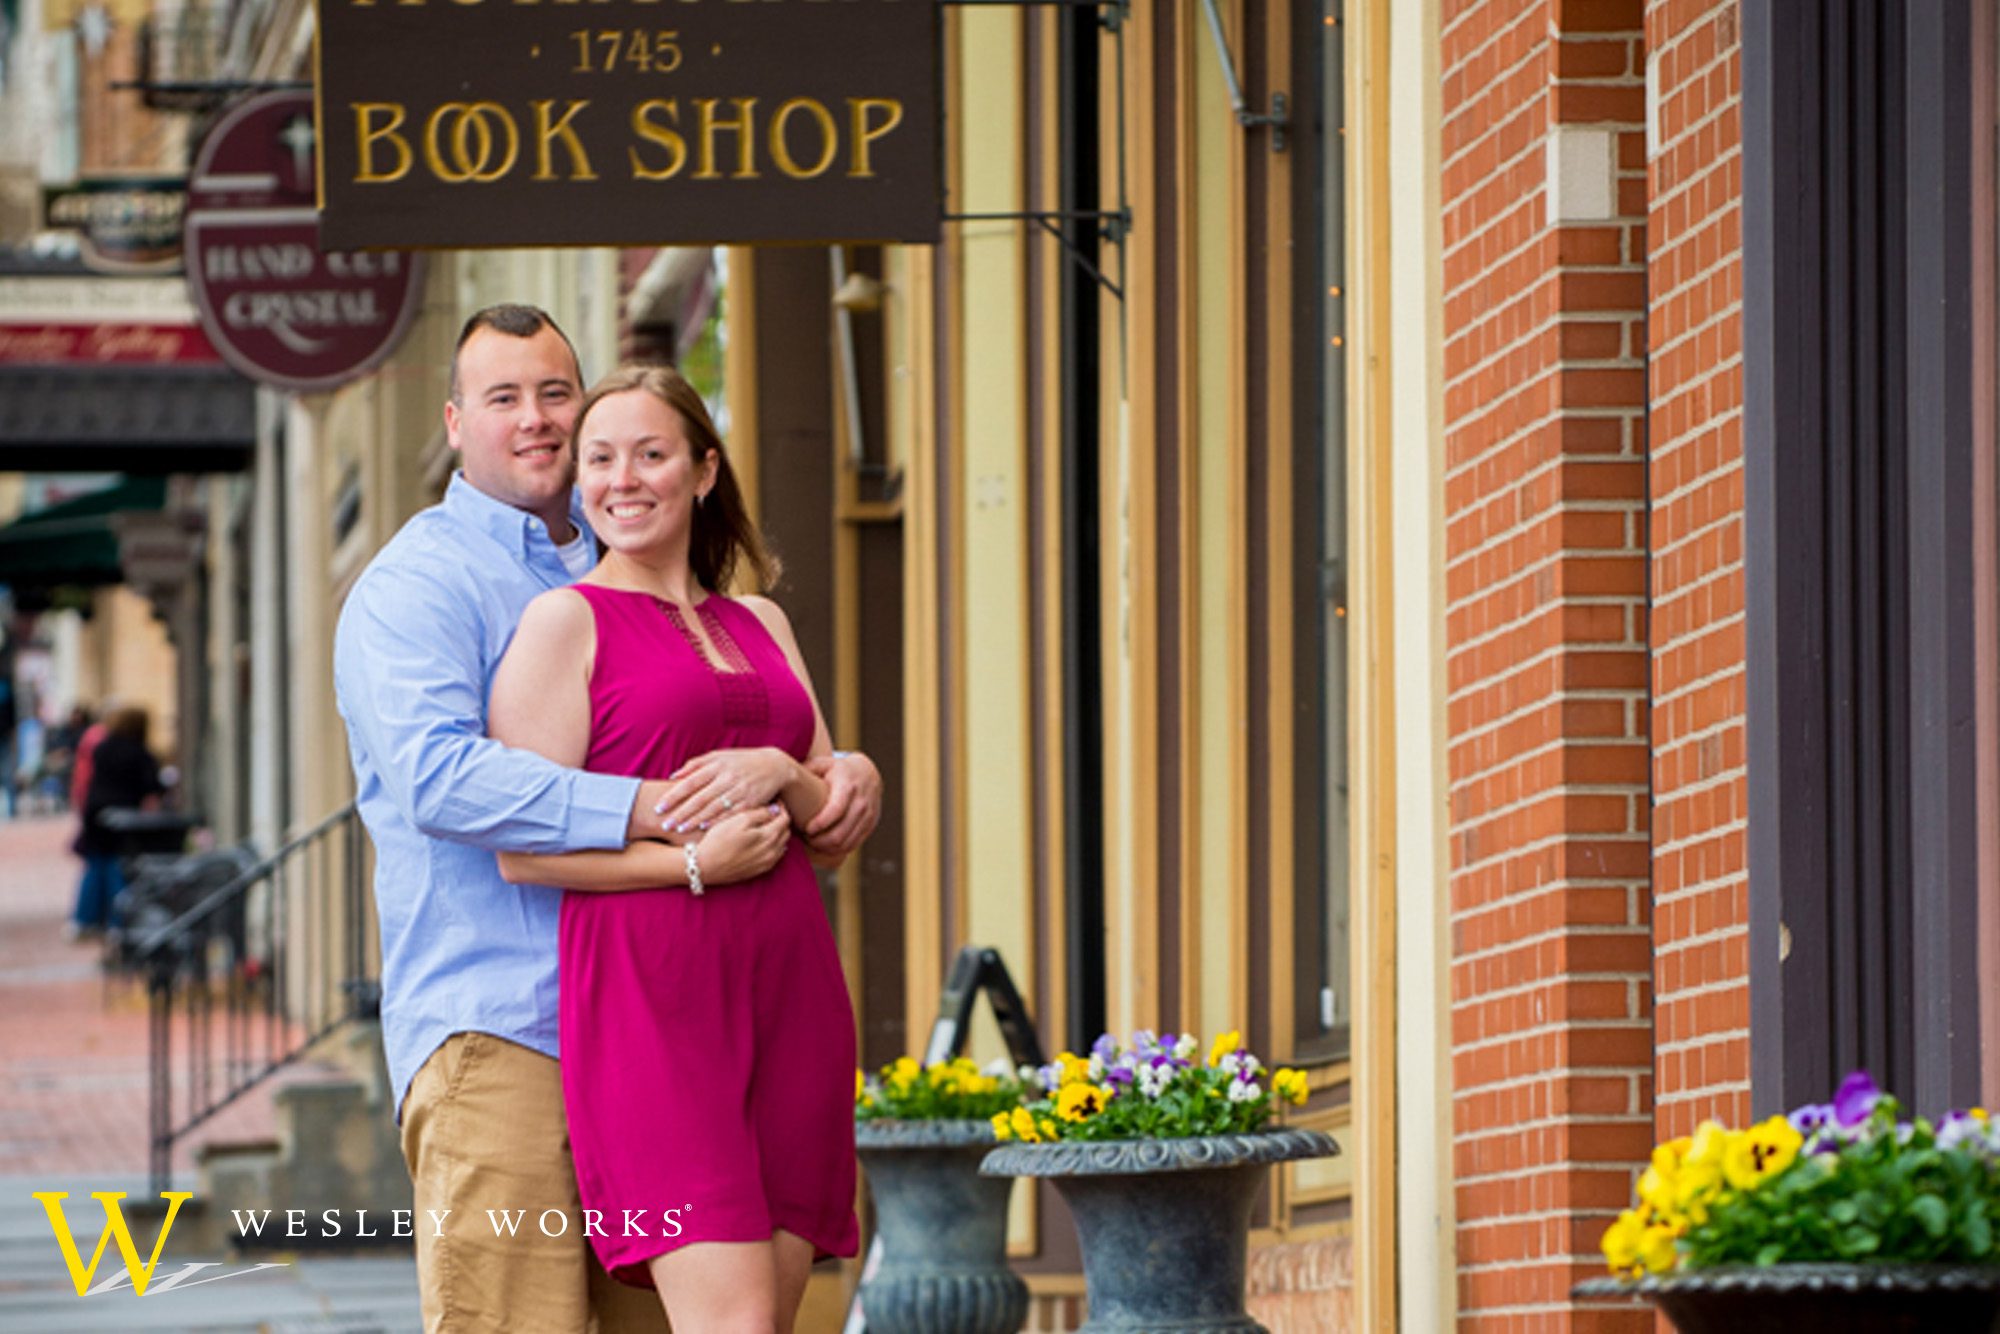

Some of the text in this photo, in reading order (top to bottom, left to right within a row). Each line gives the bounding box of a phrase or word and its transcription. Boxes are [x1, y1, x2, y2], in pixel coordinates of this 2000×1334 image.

[570, 30, 683, 72] 1745
[352, 98, 904, 184] BOOK SHOP
[205, 243, 315, 282] HAND
[224, 288, 385, 355] CRYSTAL
